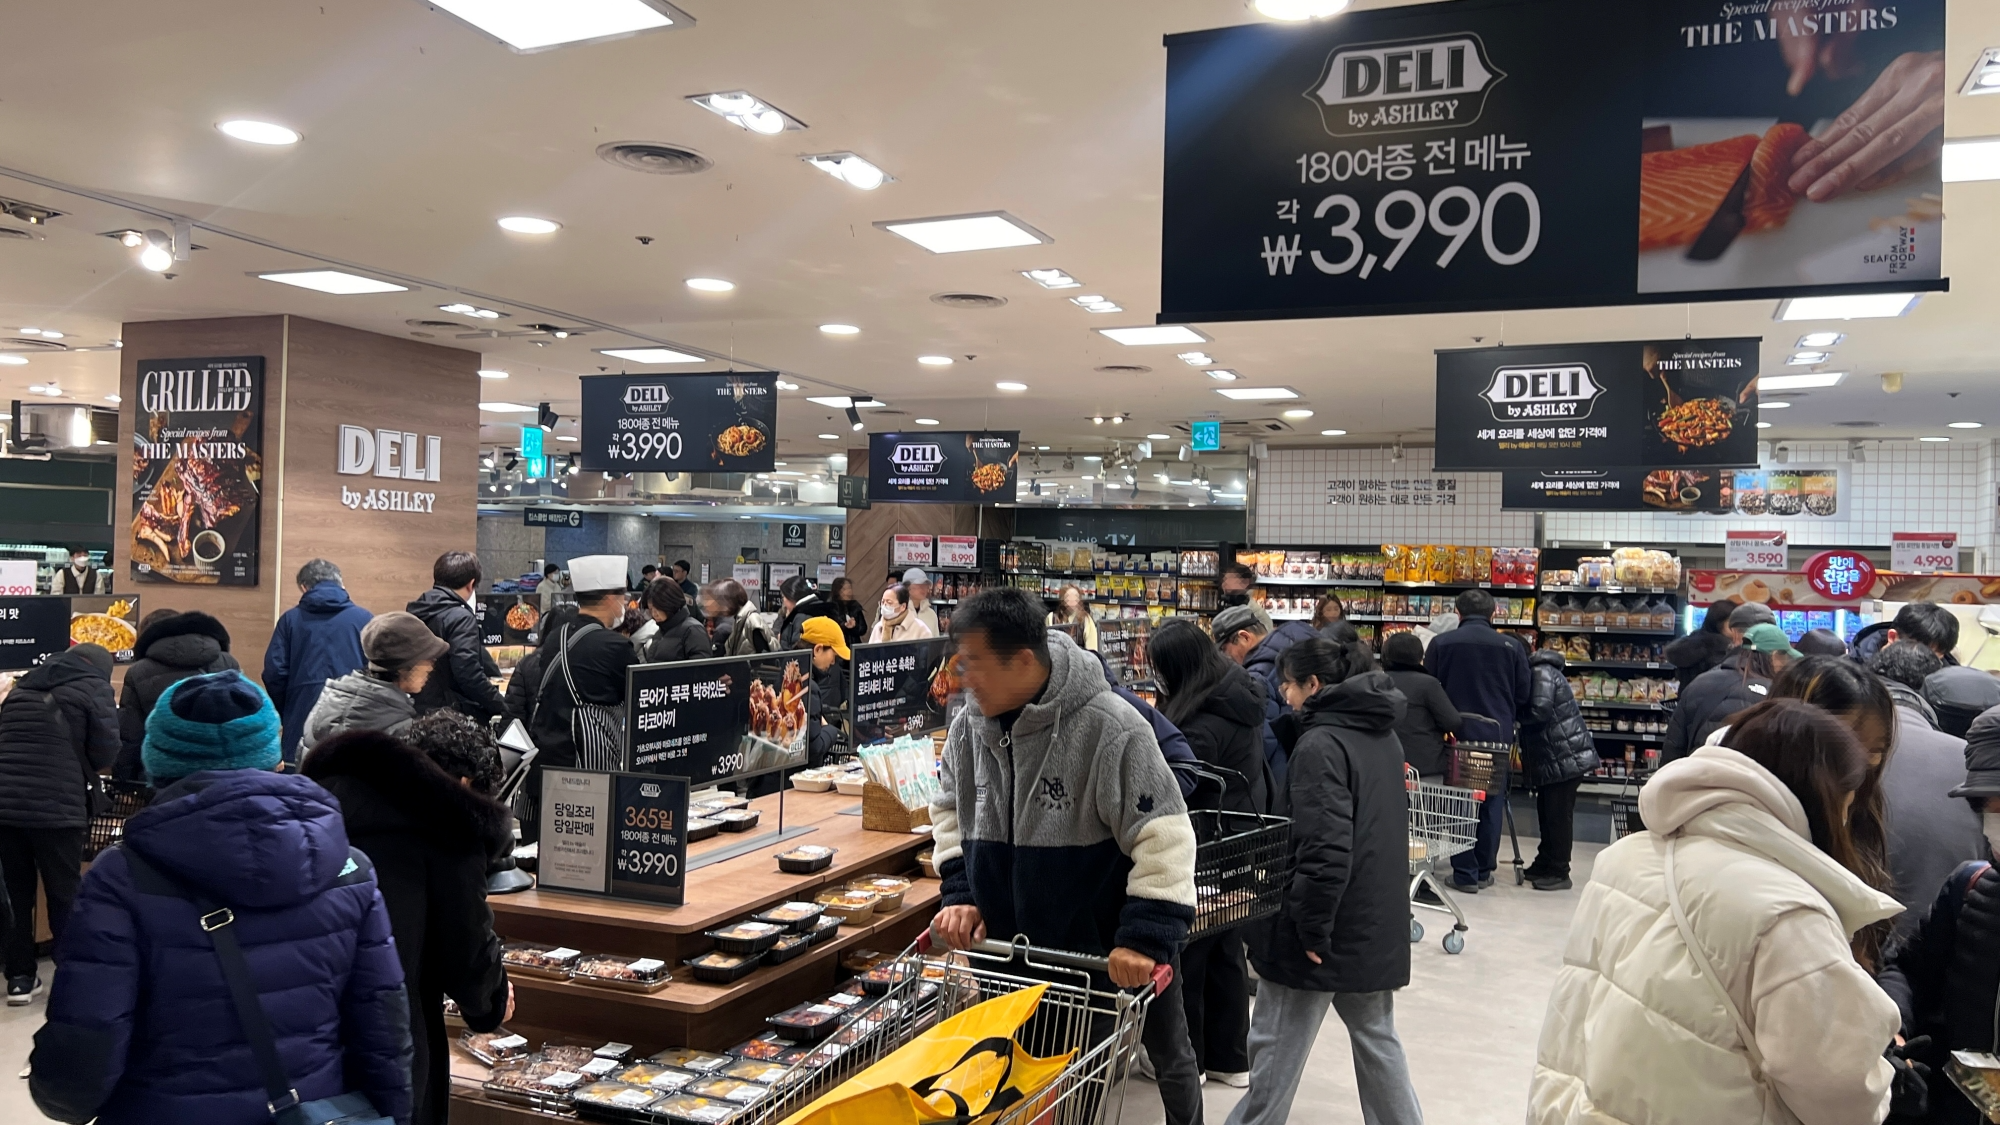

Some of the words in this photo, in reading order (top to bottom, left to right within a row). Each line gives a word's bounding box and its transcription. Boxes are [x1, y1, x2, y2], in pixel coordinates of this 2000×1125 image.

[1681, 21, 1742, 48] THE
[1753, 6, 1898, 41] MASTERS
[1342, 45, 1465, 99] DELI
[1348, 109, 1369, 128] by
[1371, 99, 1459, 127] ASHLEY
[1296, 144, 1417, 184] 180여종
[1423, 137, 1455, 176] 전
[1464, 134, 1531, 172] 메뉴
[1276, 198, 1300, 224] 각
[1899, 225, 1908, 270] NORWAY
[1863, 253, 1916, 264] SEAFOOD
[1889, 244, 1899, 274] FROM
[1657, 360, 1681, 370] THE
[1685, 358, 1742, 369] MASTERS
[141, 368, 252, 412] GRILLED
[716, 387, 731, 396] THE
[733, 387, 767, 396] MASTERS
[1503, 371, 1580, 399] DELI
[630, 388, 663, 402] DELI
[638, 404, 662, 412] ASHLEY
[1507, 404, 1521, 417] by
[1522, 402, 1577, 417] ASHLEY
[617, 417, 650, 430] 180여종
[652, 417, 661, 429] 전
[662, 416, 680, 429] 메뉴
[160, 427, 186, 442] Special
[186, 427, 210, 440] recipes
[208, 426, 228, 440] from
[612, 433, 619, 442] 각
[1477, 429, 1495, 440] 세계
[1498, 428, 1525, 440] 요리를
[1527, 428, 1555, 440] 세상에
[1558, 427, 1576, 439] 없던
[1579, 426, 1607, 438] 가격에
[141, 442, 171, 459] THE
[175, 442, 246, 459] MASTERS
[984, 441, 1011, 449] MASTERS
[337, 424, 441, 482] DELI
[900, 447, 936, 461] DELI
[901, 465, 907, 473] by
[907, 464, 934, 472] ASHLEY
[1327, 479, 1355, 491] 고객이
[1358, 479, 1387, 491] 말하는
[1436, 479, 1456, 491] 품질
[1531, 481, 1544, 489] 세계
[1545, 481, 1564, 489] 요리를
[1565, 481, 1584, 489] 세상에
[1601, 481, 1619, 489] 가격에
[341, 485, 361, 510] by
[362, 488, 435, 513] ASHLEY
[1327, 494, 1355, 506] 고객이
[1358, 494, 1387, 506] 원하는
[1390, 494, 1410, 505] 대로
[1413, 494, 1433, 505] 만든
[1436, 494, 1456, 506] 가격
[907, 552, 930, 561] 8,990
[951, 553, 974, 563] 8,990
[1746, 552, 1783, 564] 3,590
[1829, 556, 1853, 570] 맛에
[1913, 555, 1953, 567] 4,990
[1824, 569, 1860, 583] 건강을
[1830, 583, 1852, 595] 담다
[9, 608, 19, 619] 맛
[859, 662, 871, 678] 겉은
[872, 660, 885, 675] 바삭
[885, 658, 897, 673] 속은
[899, 656, 915, 671] 촉촉한
[882, 676, 894, 692] 치킨
[639, 686, 668, 708] 문어가
[671, 684, 690, 703] 콕콕
[638, 708, 675, 732] 타코야끼
[554, 803, 595, 820] 당일조리
[625, 806, 673, 830] 365일
[554, 820, 594, 837] 당일판매
[620, 830, 650, 843] 180여종
[651, 832, 660, 844] 전
[661, 833, 677, 846] 메뉴
[621, 849, 627, 857] 각
